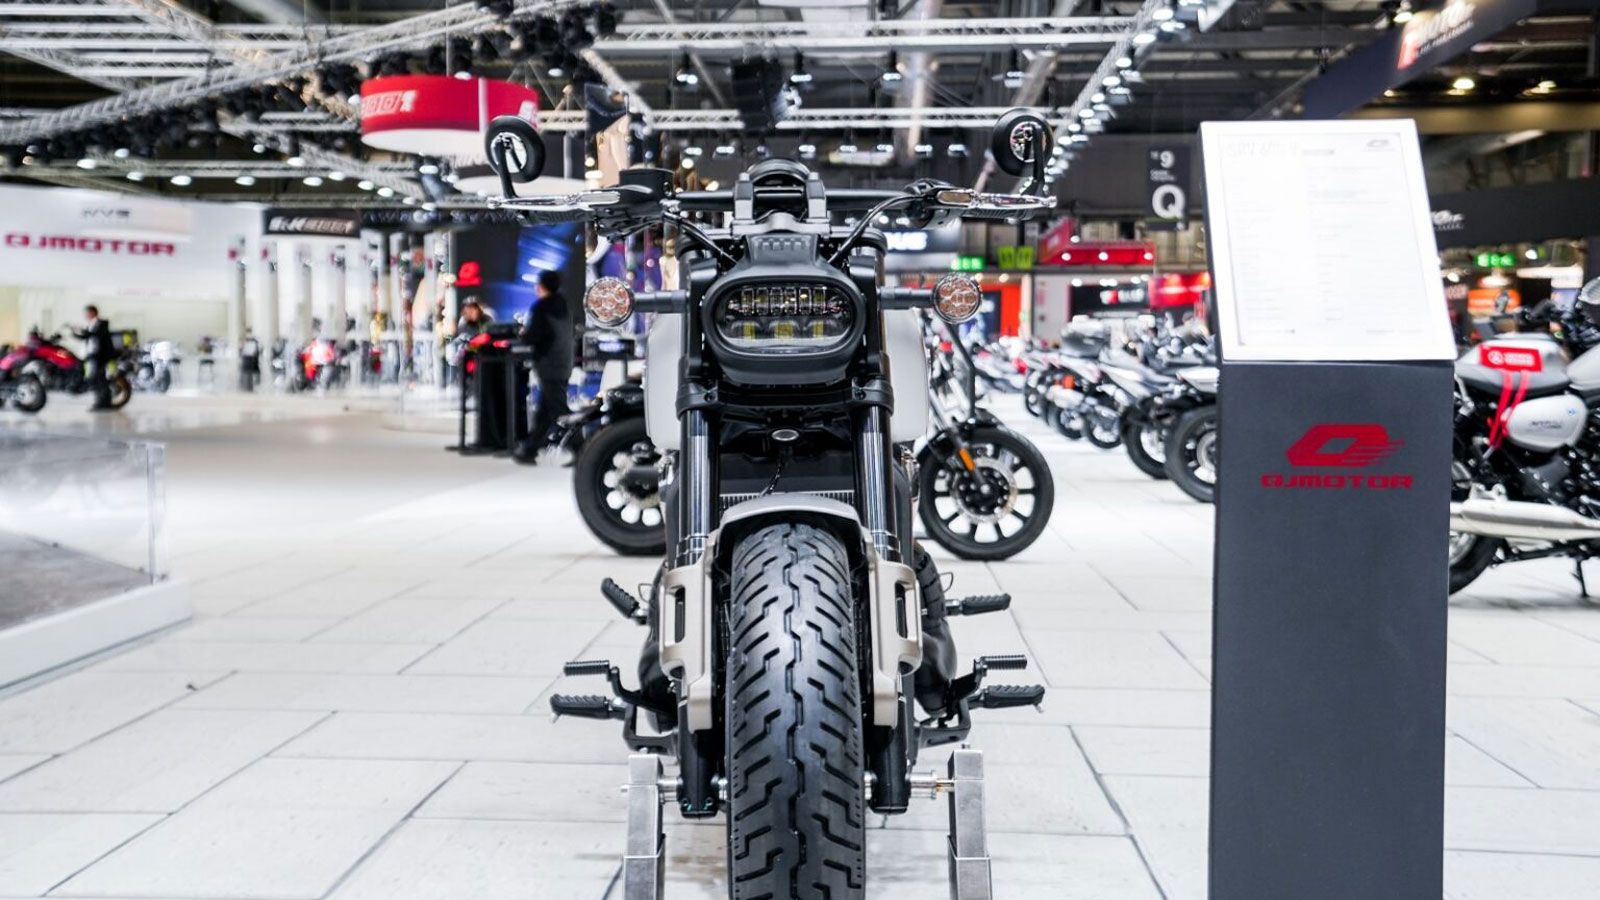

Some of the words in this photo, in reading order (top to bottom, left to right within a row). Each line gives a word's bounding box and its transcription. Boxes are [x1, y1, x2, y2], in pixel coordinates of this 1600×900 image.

[1152, 184, 1185, 219] Q
[5, 233, 175, 256] QJMOTOR
[1260, 474, 1413, 489] QJMOTOR
